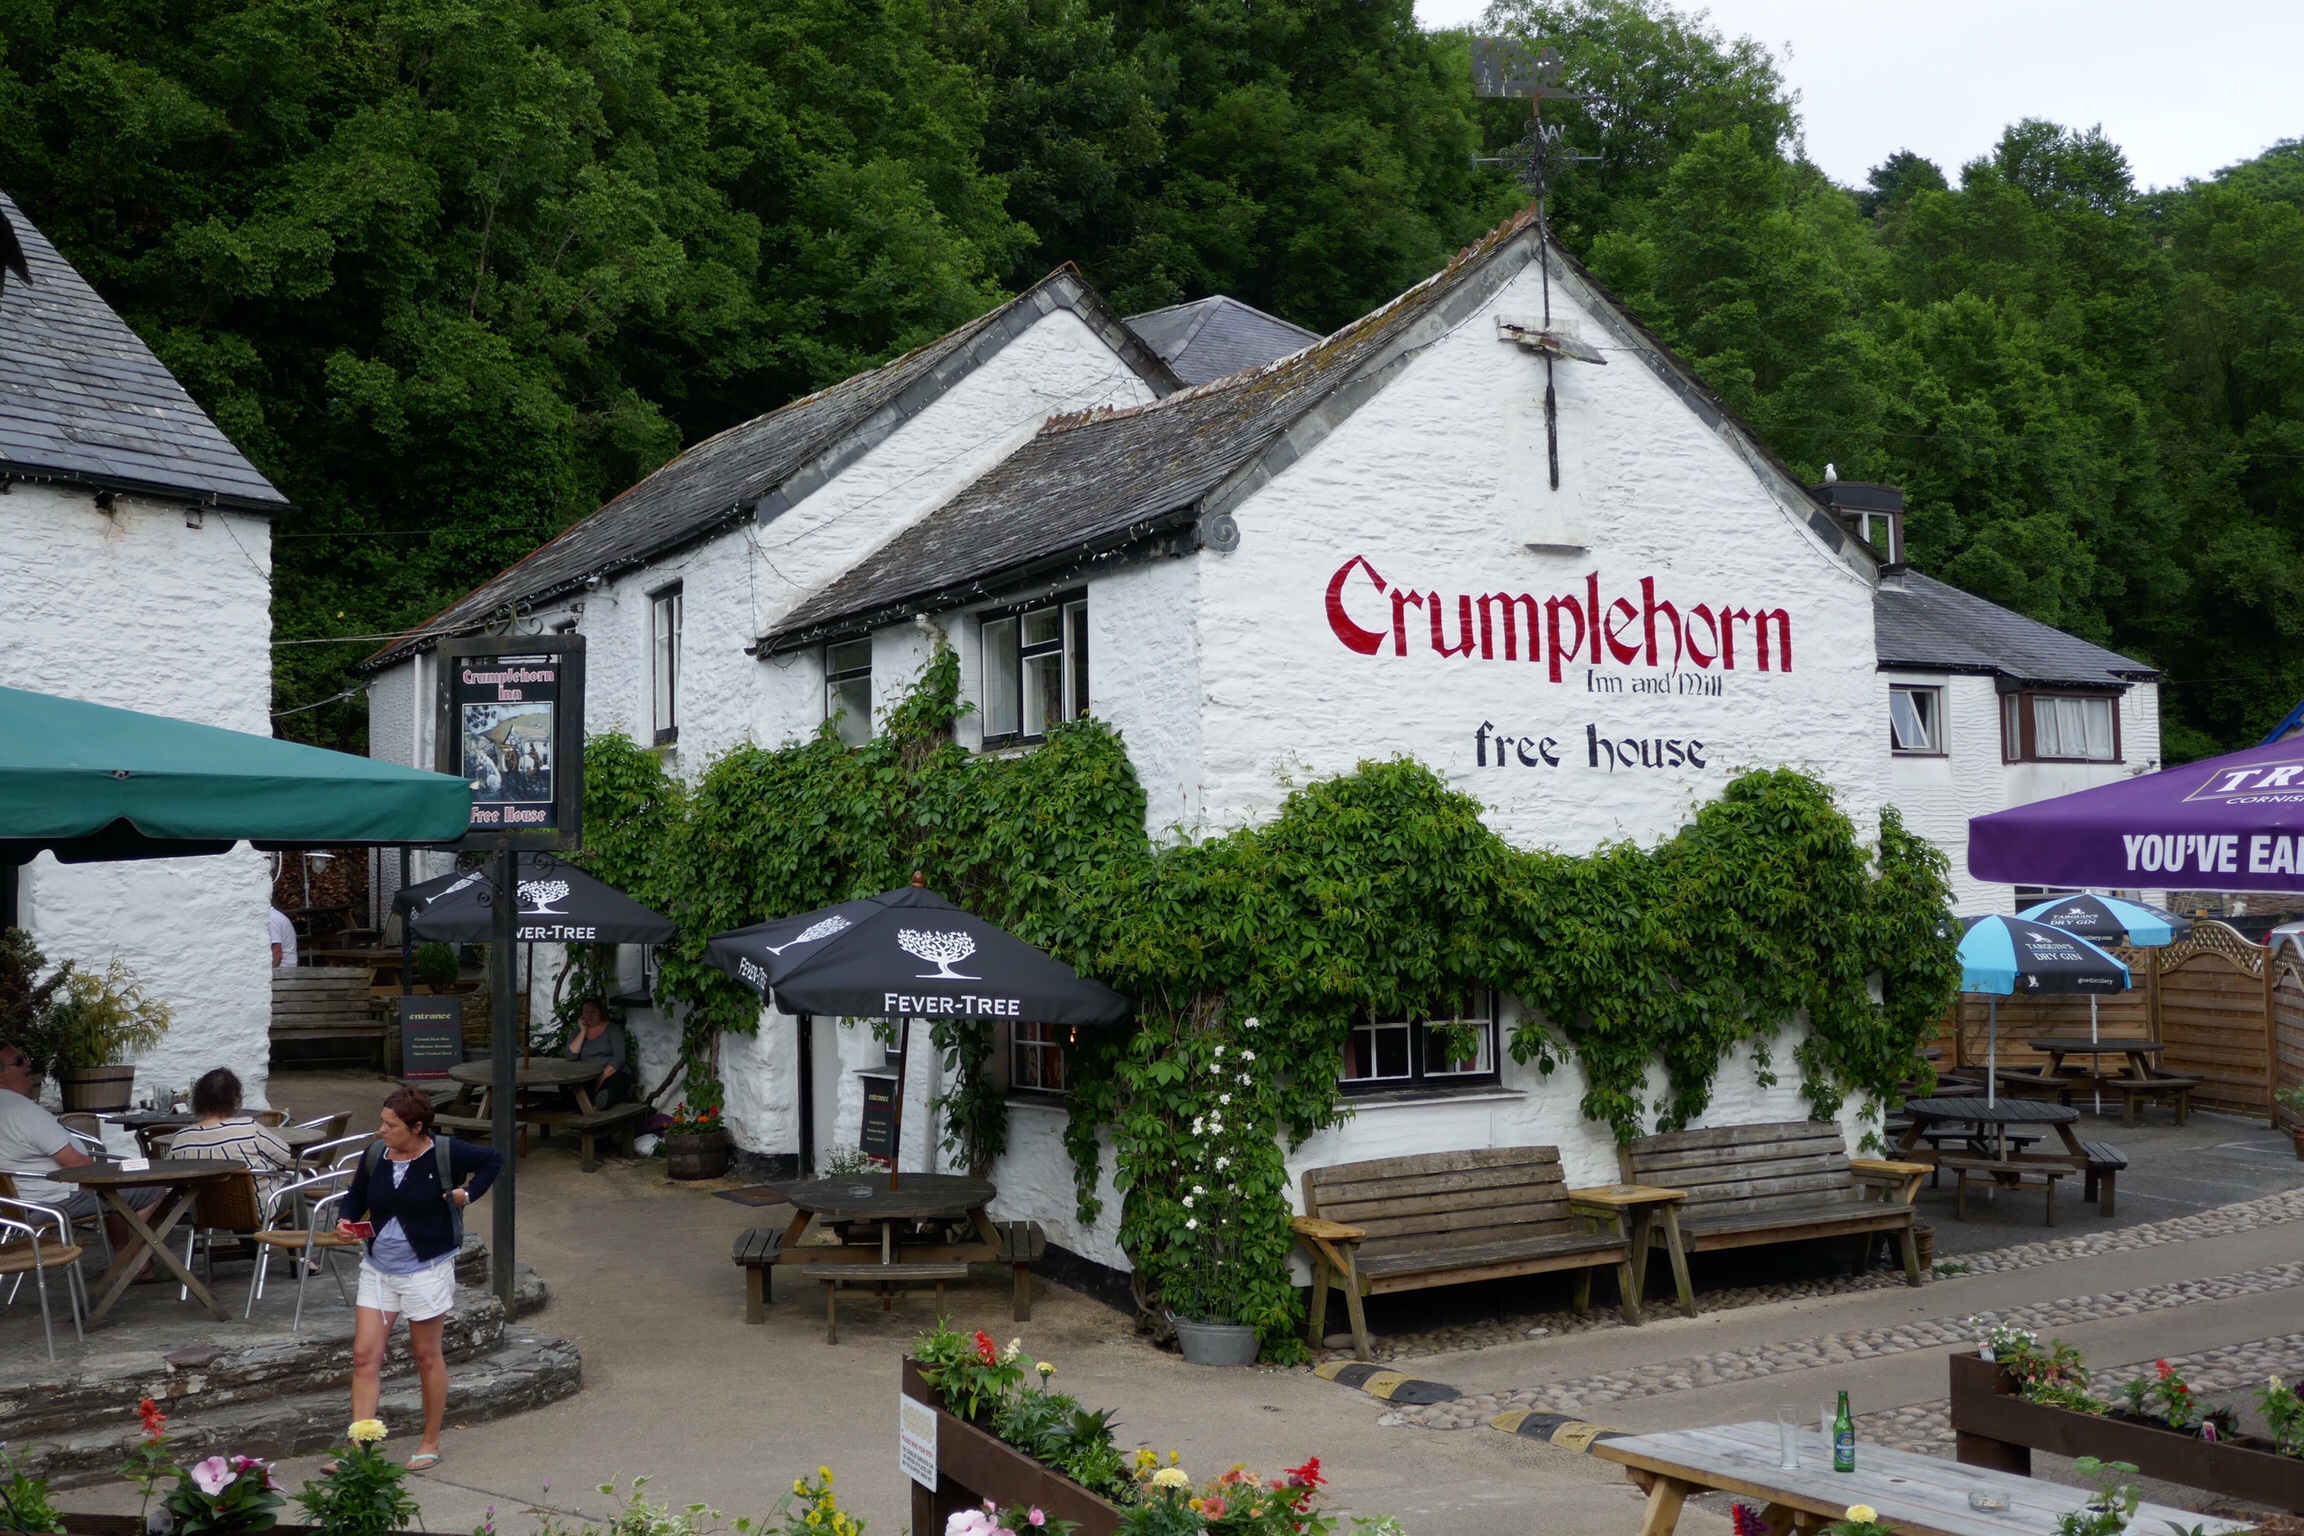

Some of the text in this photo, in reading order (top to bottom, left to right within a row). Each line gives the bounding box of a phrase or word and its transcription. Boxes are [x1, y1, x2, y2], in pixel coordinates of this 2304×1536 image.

[1325, 554, 1792, 684] Crumplehorn
[463, 668, 554, 688] Crumplehorn
[1587, 669, 1722, 697] Inn and Mill
[498, 688, 522, 700] Inn
[1475, 720, 1707, 773] free house
[2215, 766, 2304, 793] TR
[470, 806, 546, 823] Free House
[2122, 834, 2239, 873] YOU'VE
[516, 925, 596, 939] VER-TREE
[2034, 953, 2083, 961] DRY GIN
[738, 957, 768, 990] FEVER-TREE
[884, 993, 1021, 1016] FEVER-TREE
[868, 1093, 889, 1102] entrance
